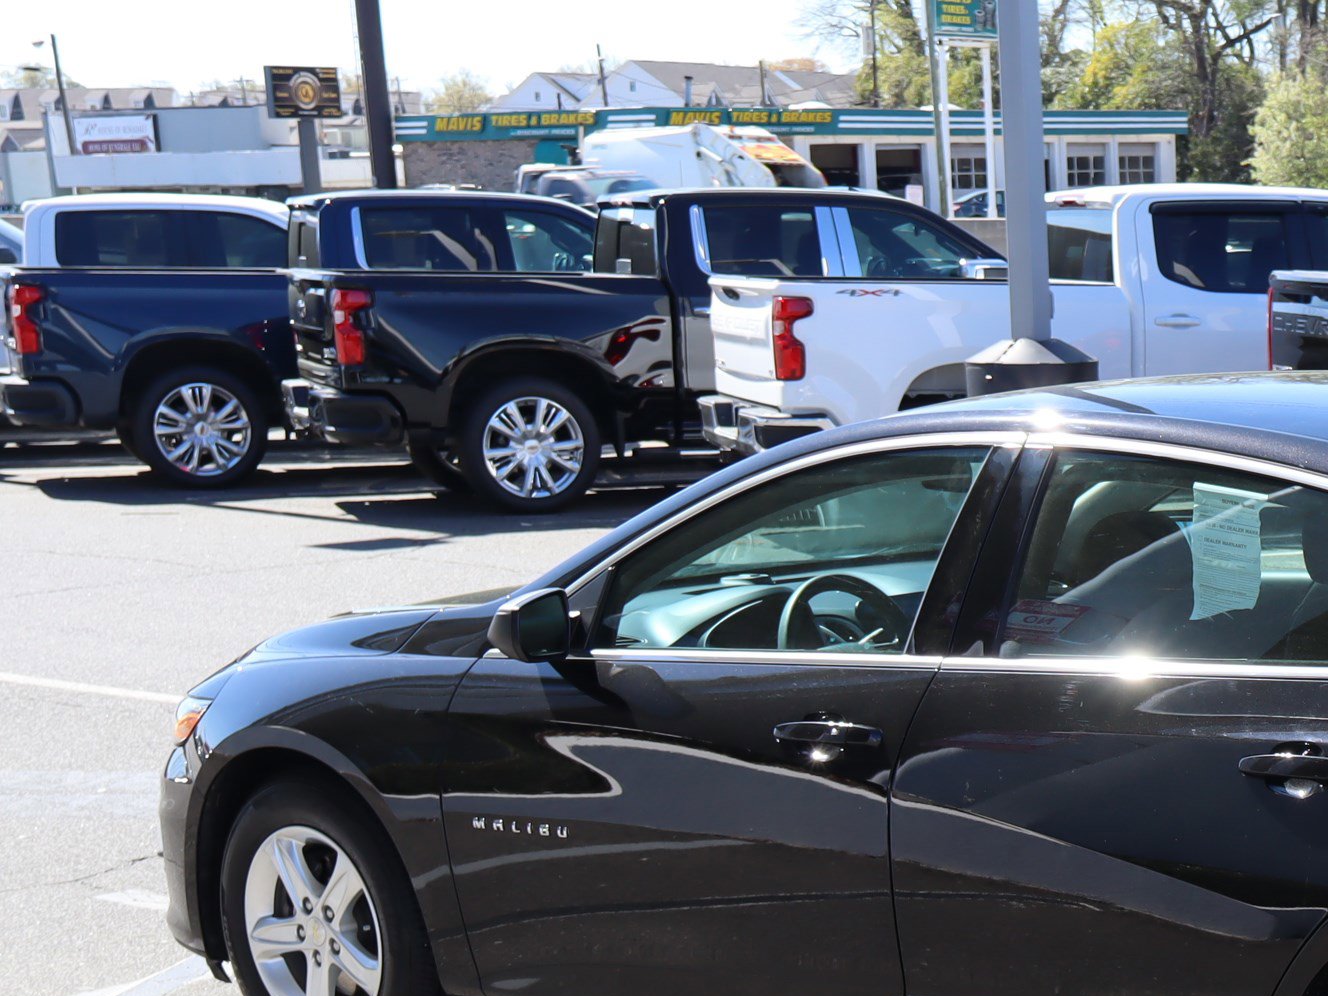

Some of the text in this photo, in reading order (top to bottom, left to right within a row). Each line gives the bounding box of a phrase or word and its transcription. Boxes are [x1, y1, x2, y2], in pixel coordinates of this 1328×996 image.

[435, 116, 483, 132] MAVIS
[491, 114, 528, 127] TIRES
[540, 112, 595, 126] BRAKES
[670, 111, 722, 125] MAVIS
[731, 111, 769, 123] TIRES
[781, 111, 833, 123] BRAKES
[472, 817, 568, 839] MALIBU
